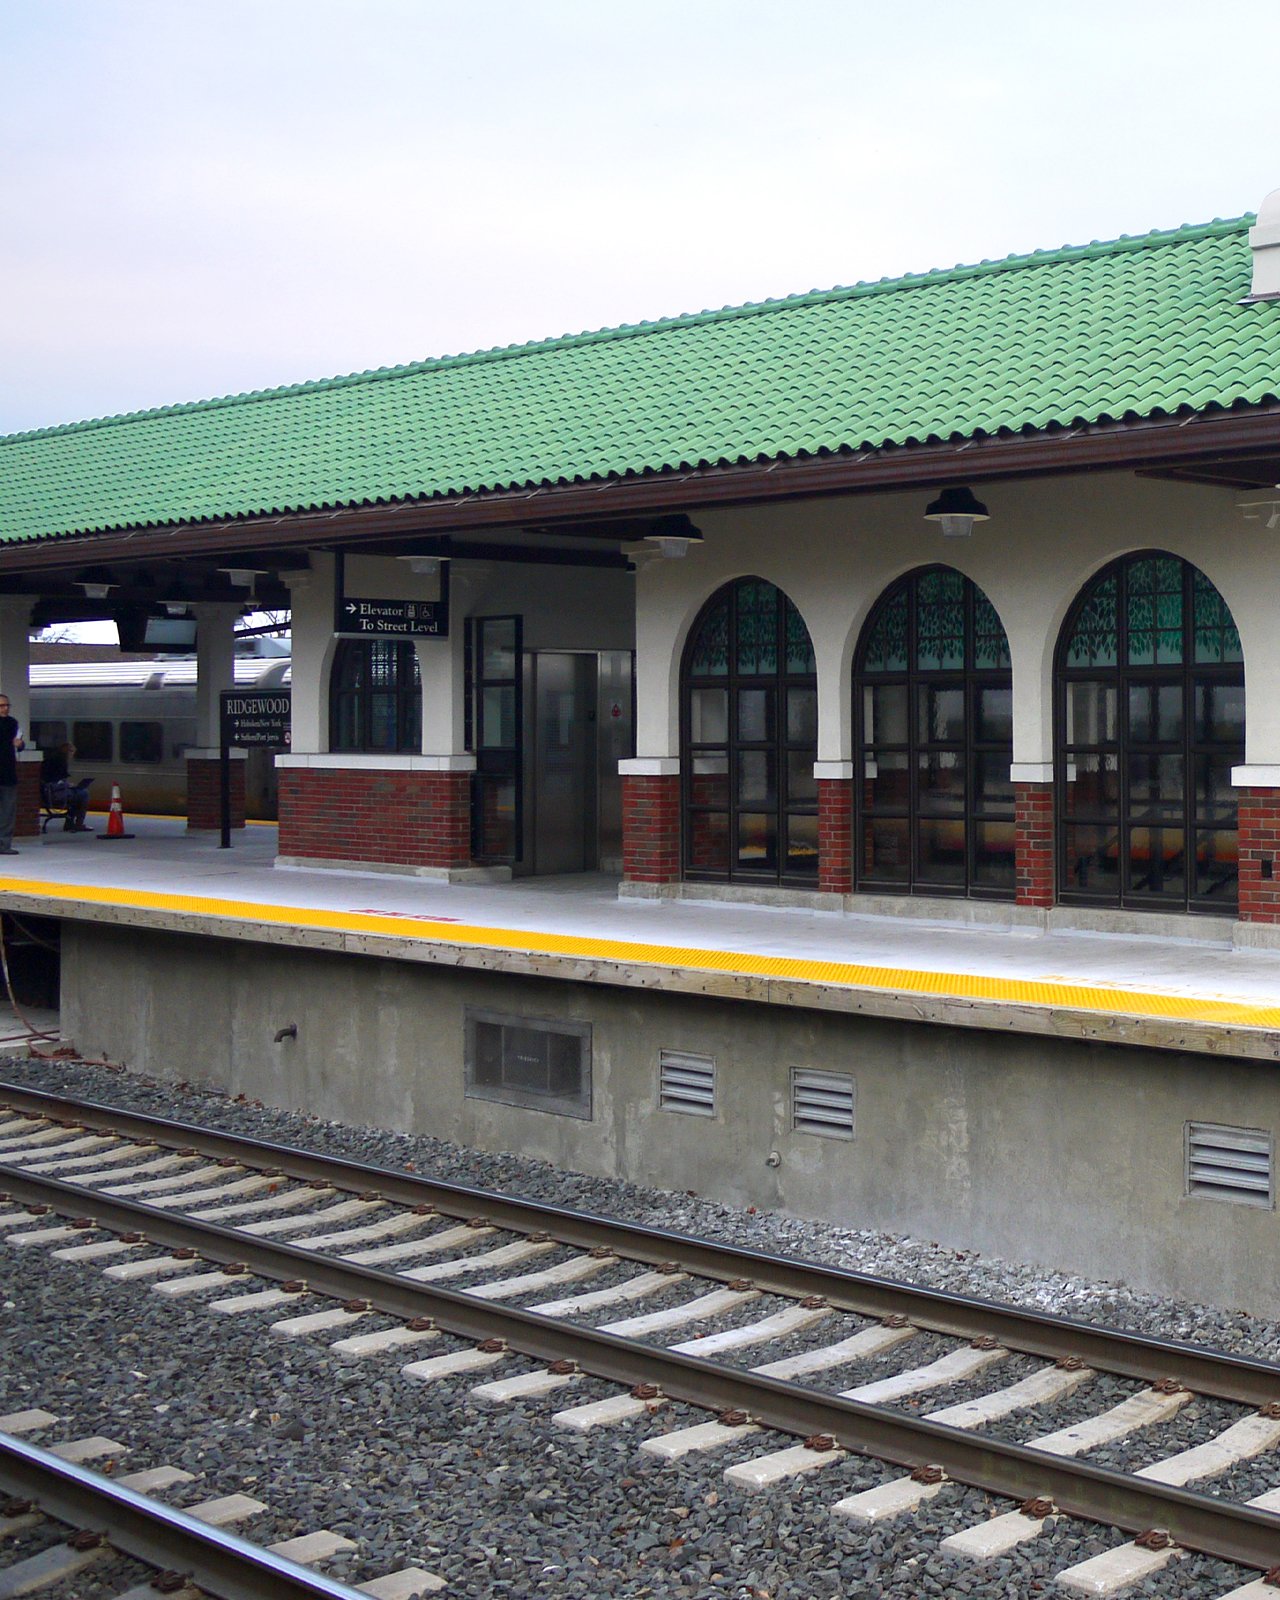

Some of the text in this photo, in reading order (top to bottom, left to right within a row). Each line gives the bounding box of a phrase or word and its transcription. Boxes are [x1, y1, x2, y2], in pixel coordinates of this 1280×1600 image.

[360, 603, 404, 616] Elevator
[360, 618, 438, 633] To Street Level
[226, 698, 290, 715] RIDGEWOOD
